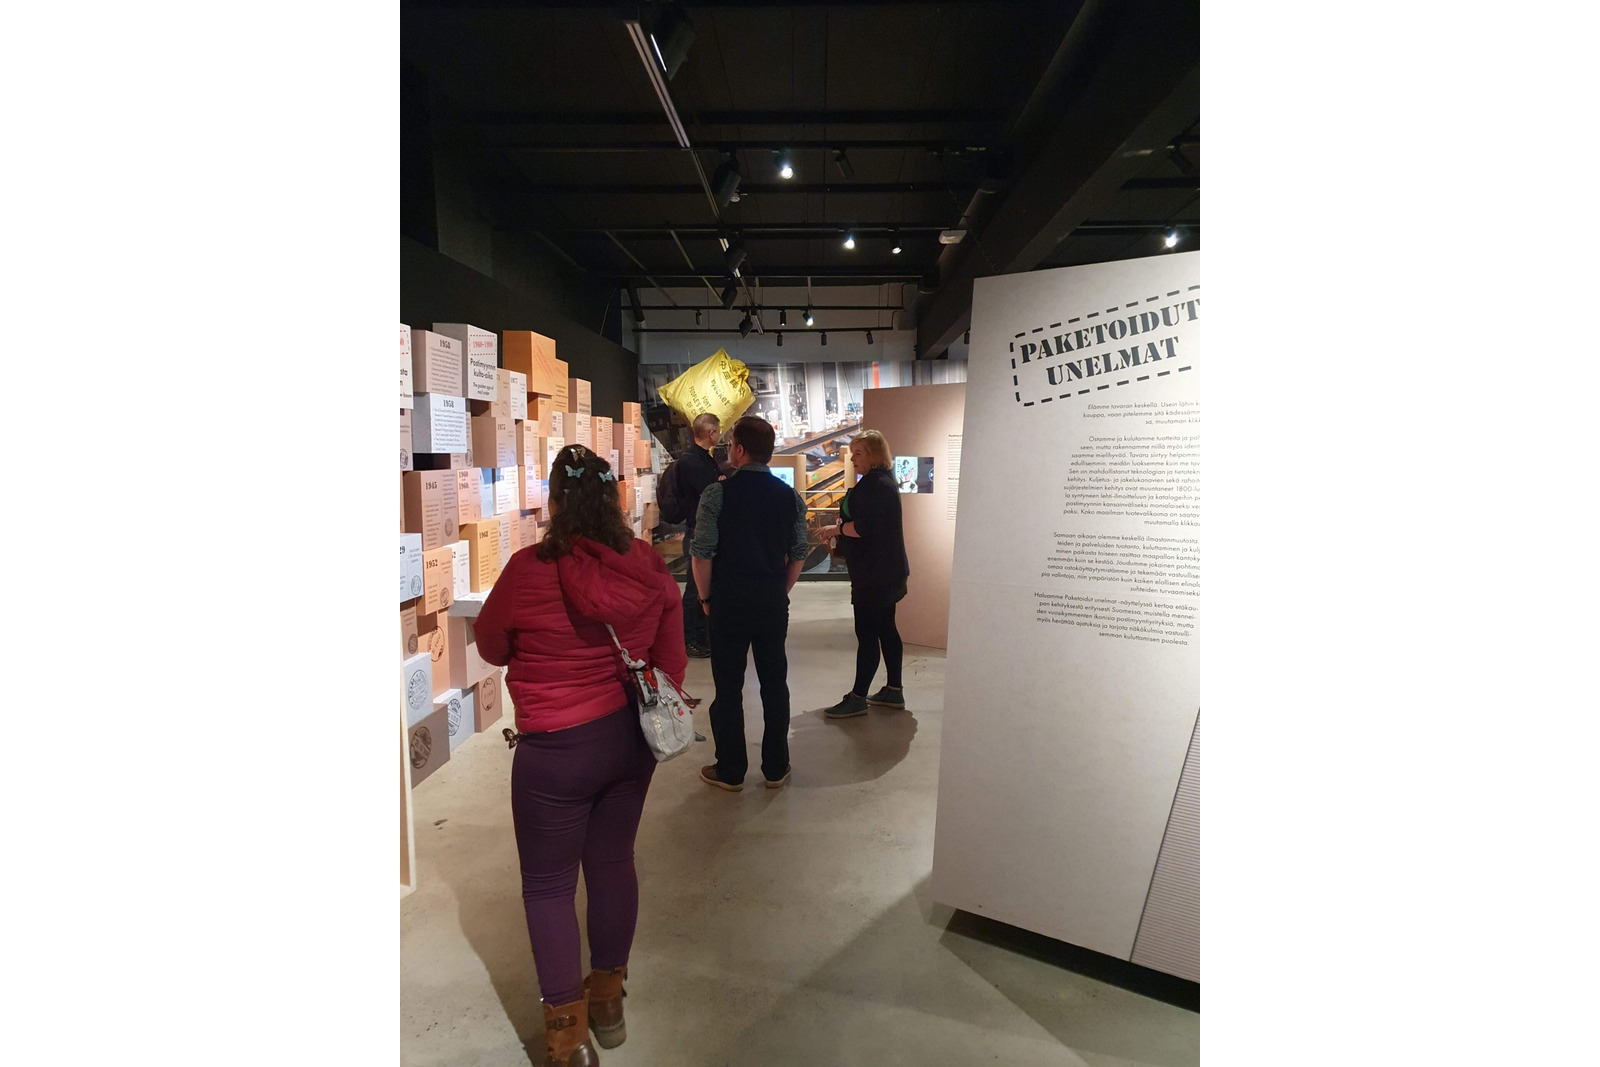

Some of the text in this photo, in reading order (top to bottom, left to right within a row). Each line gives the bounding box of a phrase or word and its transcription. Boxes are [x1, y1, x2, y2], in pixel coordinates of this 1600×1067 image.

[1020, 298, 1200, 363] PAKETOIDUT
[1046, 336, 1179, 385] UNELMAT
[1123, 409, 1153, 418] pitelemme
[1167, 443, 1182, 451] myös
[1071, 459, 1107, 468] edullisemmin,
[1130, 468, 1165, 476] teknologian
[1067, 475, 1087, 484] kehitys.
[1088, 475, 1112, 484] Kuljetus-
[1120, 476, 1164, 484] jakelukanavien
[1063, 483, 1103, 492] sujärjestelmien
[1104, 484, 1124, 492] kehitys
[1072, 492, 1099, 500] syntyneen
[1155, 493, 1193, 502] katalogeihin
[1066, 500, 1102, 508] postimyynnin
[1103, 500, 1148, 508] kansainväliseksi
[1063, 507, 1079, 516] paksi.
[1082, 540, 1115, 550] palveluiden
[1116, 542, 1141, 551] tuotanto,
[1142, 543, 1181, 552] kuluttaminen
[1073, 548, 1097, 557] paikasta
[1142, 551, 1174, 561] maapallon
[1176, 553, 1200, 563] kantoky
[1064, 563, 1129, 576] ostokäyttäytymistämme
[1137, 568, 1166, 577] tekemään
[1116, 558, 1147, 567] Joudumme
[1148, 560, 1175, 570] jokainen
[1041, 571, 1050, 579] pia
[1051, 571, 1076, 581] valintoja,
[1088, 574, 1119, 584] ympäristön
[1134, 576, 1153, 584] kaiken
[1155, 578, 1180, 586] elollisen
[1130, 585, 1200, 596] suhteiden turvaamiseksi
[1034, 590, 1063, 600] Haluamme
[1064, 593, 1094, 602] Paketoidut
[1095, 595, 1117, 604] unelmat
[1154, 600, 1174, 609] kertoa
[1175, 602, 1199, 611] etäkau-
[1051, 601, 1083, 612] kehityksestä
[1085, 604, 1110, 614] erityisesti
[1112, 606, 1142, 616] Suomessa,
[1144, 608, 1170, 617] muistella
[1171, 611, 1197, 620] mennei-
[1048, 608, 1092, 621] vuosikymmenten
[1094, 612, 1115, 621] ikonisia
[1116, 614, 1175, 628] postimyyntiyrityksiä,
[1036, 616, 1051, 625] myös
[1052, 617, 1074, 626] herättää
[1076, 619, 1100, 630] ajatuksia
[1109, 623, 1128, 632] tarjota
[1129, 624, 1164, 634] näkökulmia
[1165, 627, 1192, 637] vastuulli-
[1124, 632, 1160, 643] kuluttamisen
[1161, 636, 1189, 647] puolesta.
